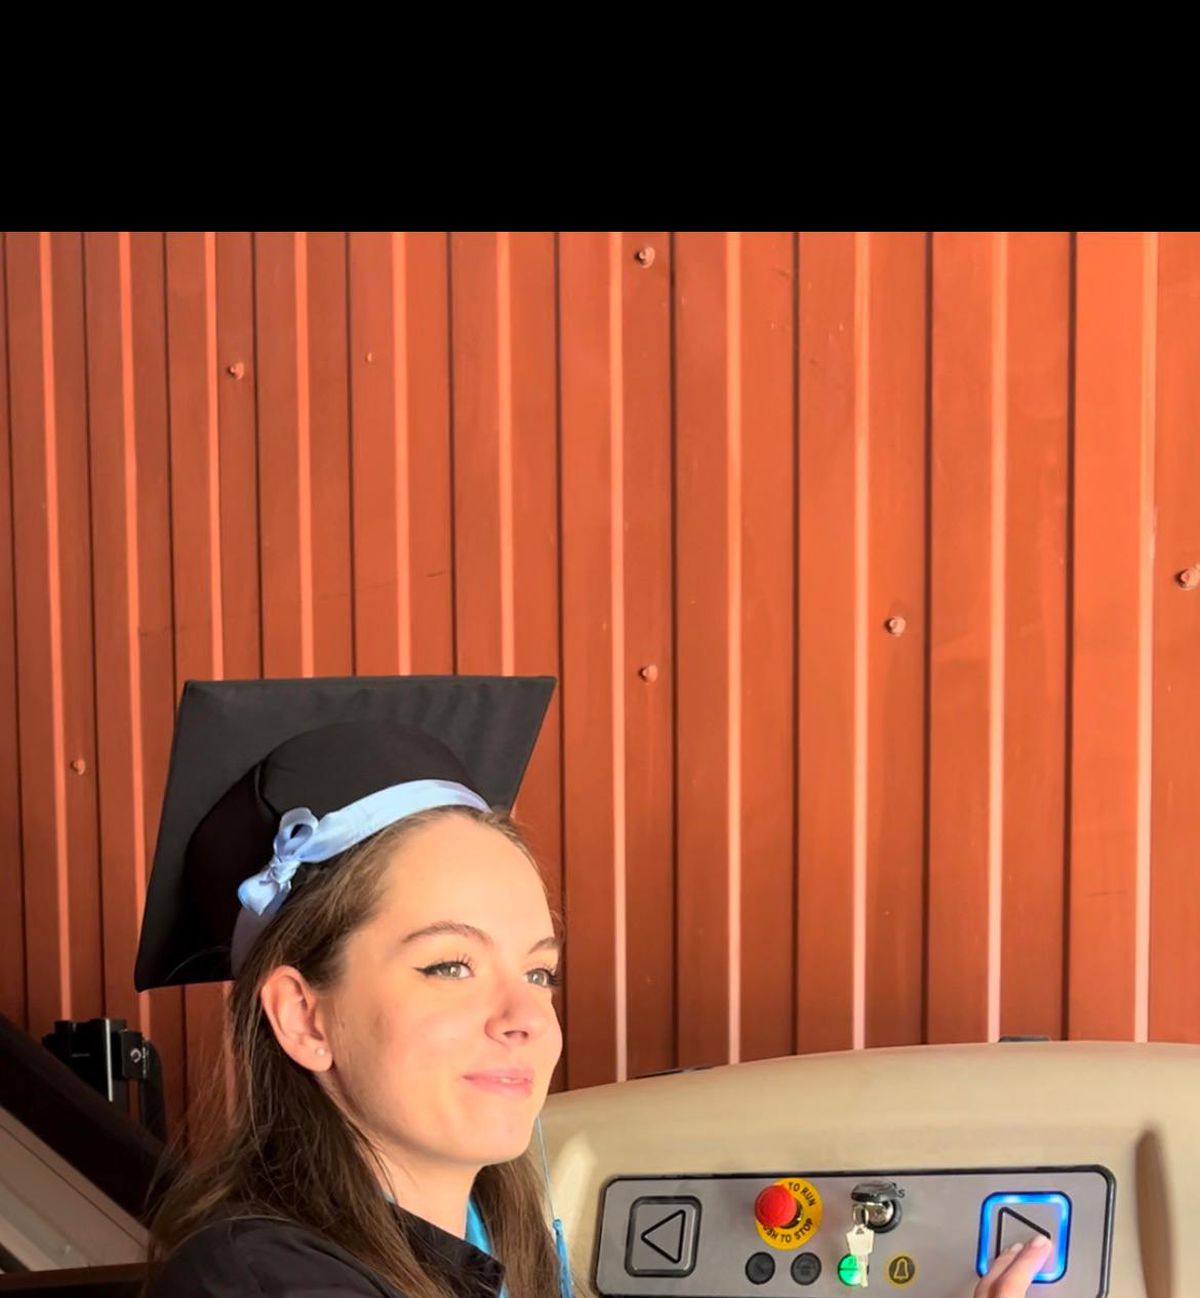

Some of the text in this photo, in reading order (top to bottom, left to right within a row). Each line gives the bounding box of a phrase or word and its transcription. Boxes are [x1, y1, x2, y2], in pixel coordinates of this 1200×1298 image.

[788, 1182, 816, 1207] TO RUN
[781, 1234, 792, 1243] TO
[794, 1218, 813, 1240] STOP
